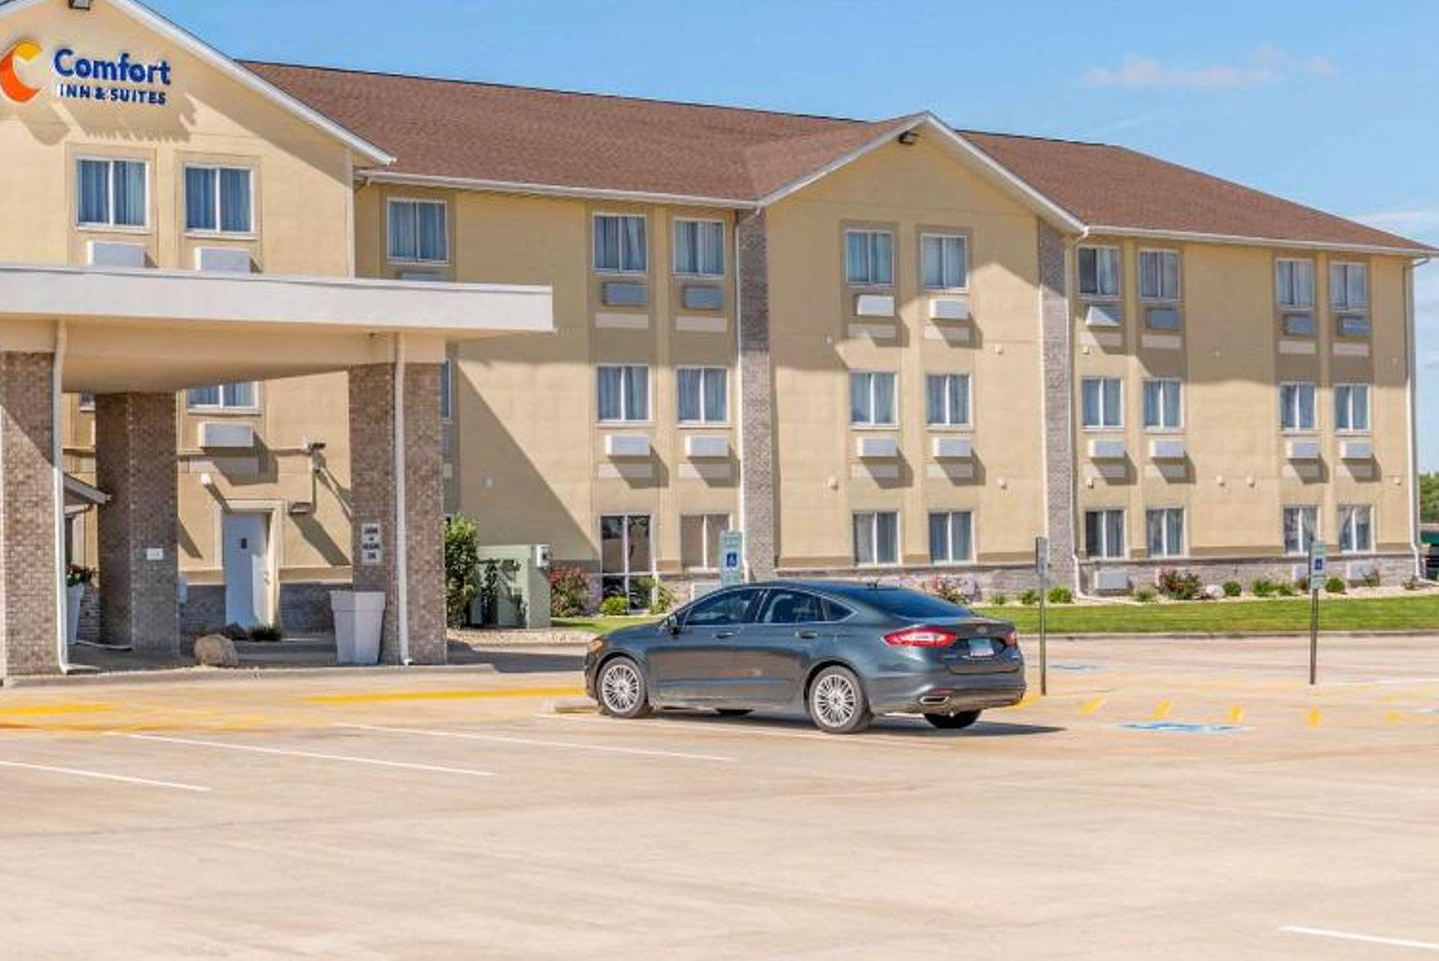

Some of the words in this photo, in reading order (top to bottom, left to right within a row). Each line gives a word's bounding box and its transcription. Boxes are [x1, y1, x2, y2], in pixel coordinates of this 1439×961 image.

[54, 48, 171, 85] Comfort
[60, 84, 91, 99] INN
[110, 87, 167, 105] SUITES
